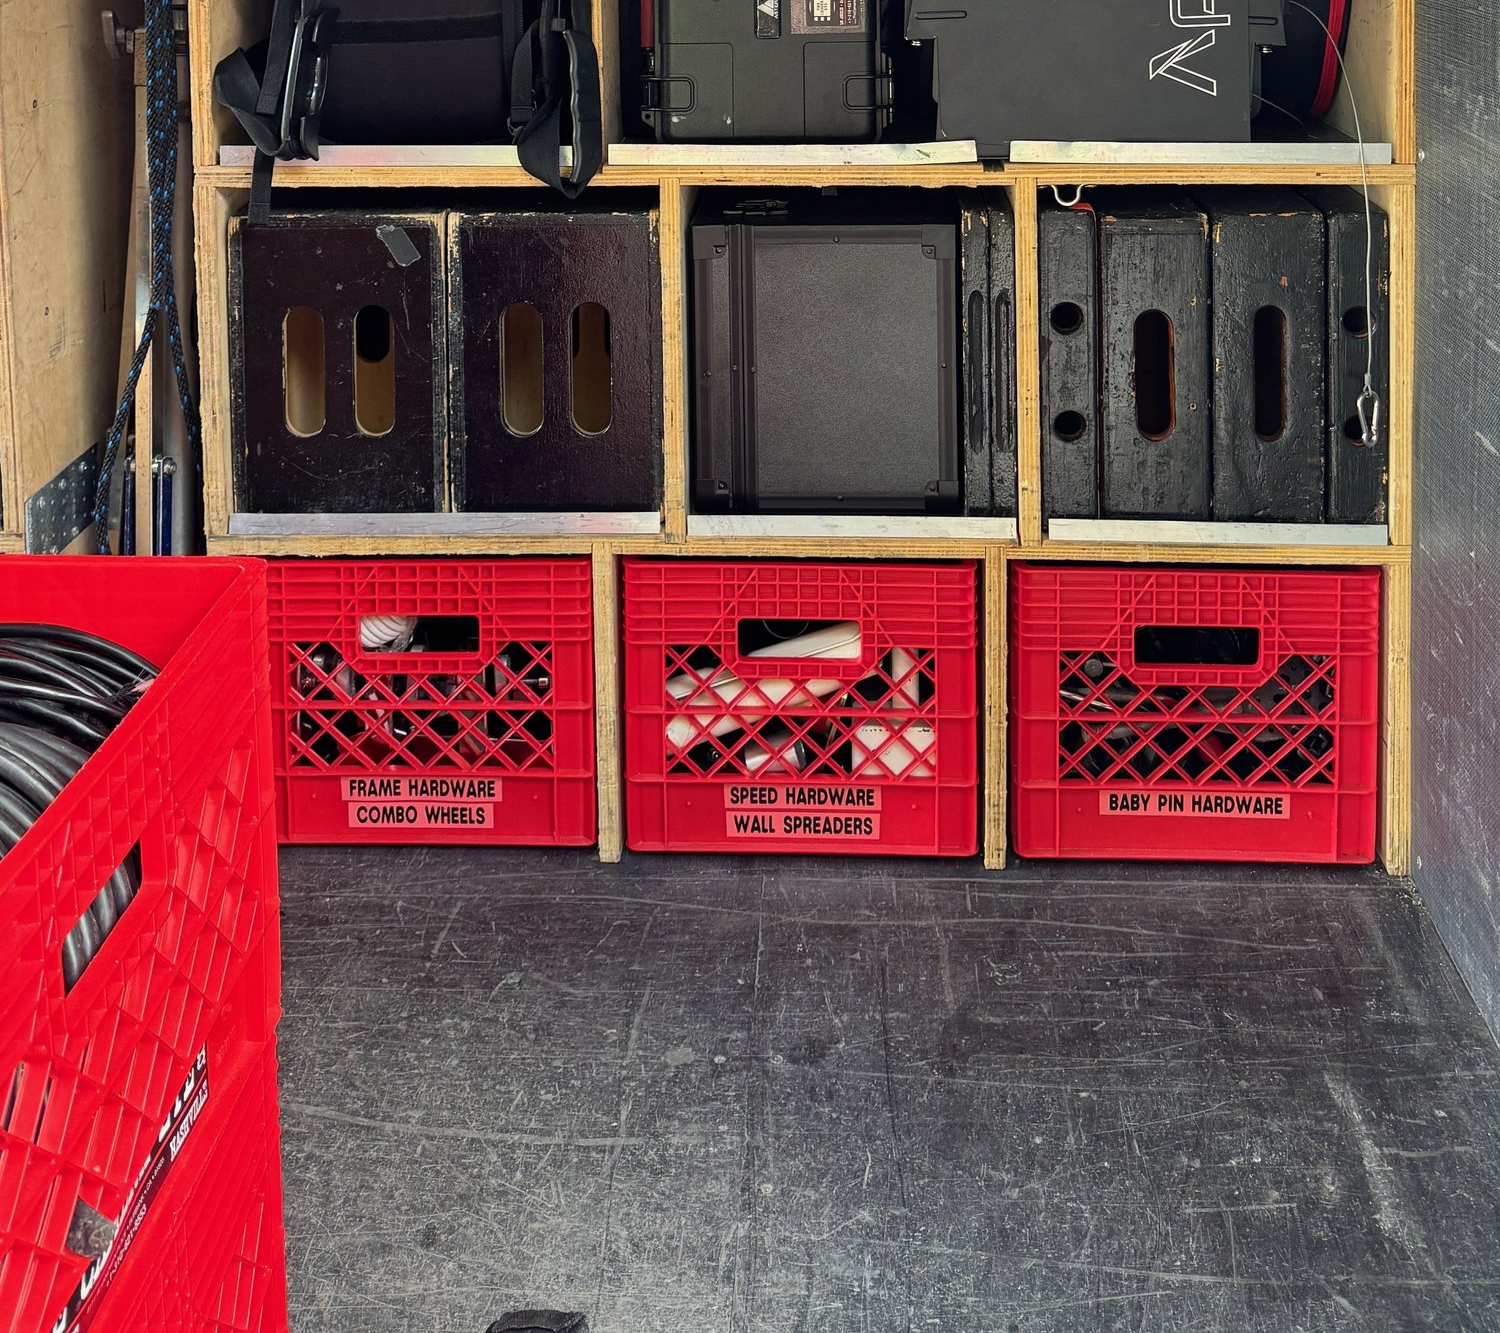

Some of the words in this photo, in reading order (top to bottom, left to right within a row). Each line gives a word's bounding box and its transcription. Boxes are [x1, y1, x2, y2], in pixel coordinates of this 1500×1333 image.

[349, 778, 402, 797] FRAME
[408, 779, 496, 798] HARDWARE
[730, 786, 778, 805] SPEED
[785, 786, 875, 806] HARDWARE
[1109, 793, 1151, 812] BABY
[1157, 794, 1185, 813] PIN
[1191, 794, 1284, 815] HARDWARE
[356, 805, 418, 824] COMBO
[424, 805, 486, 825] WHEELS
[733, 814, 776, 834] WALL
[783, 815, 873, 835] SPREADERS
